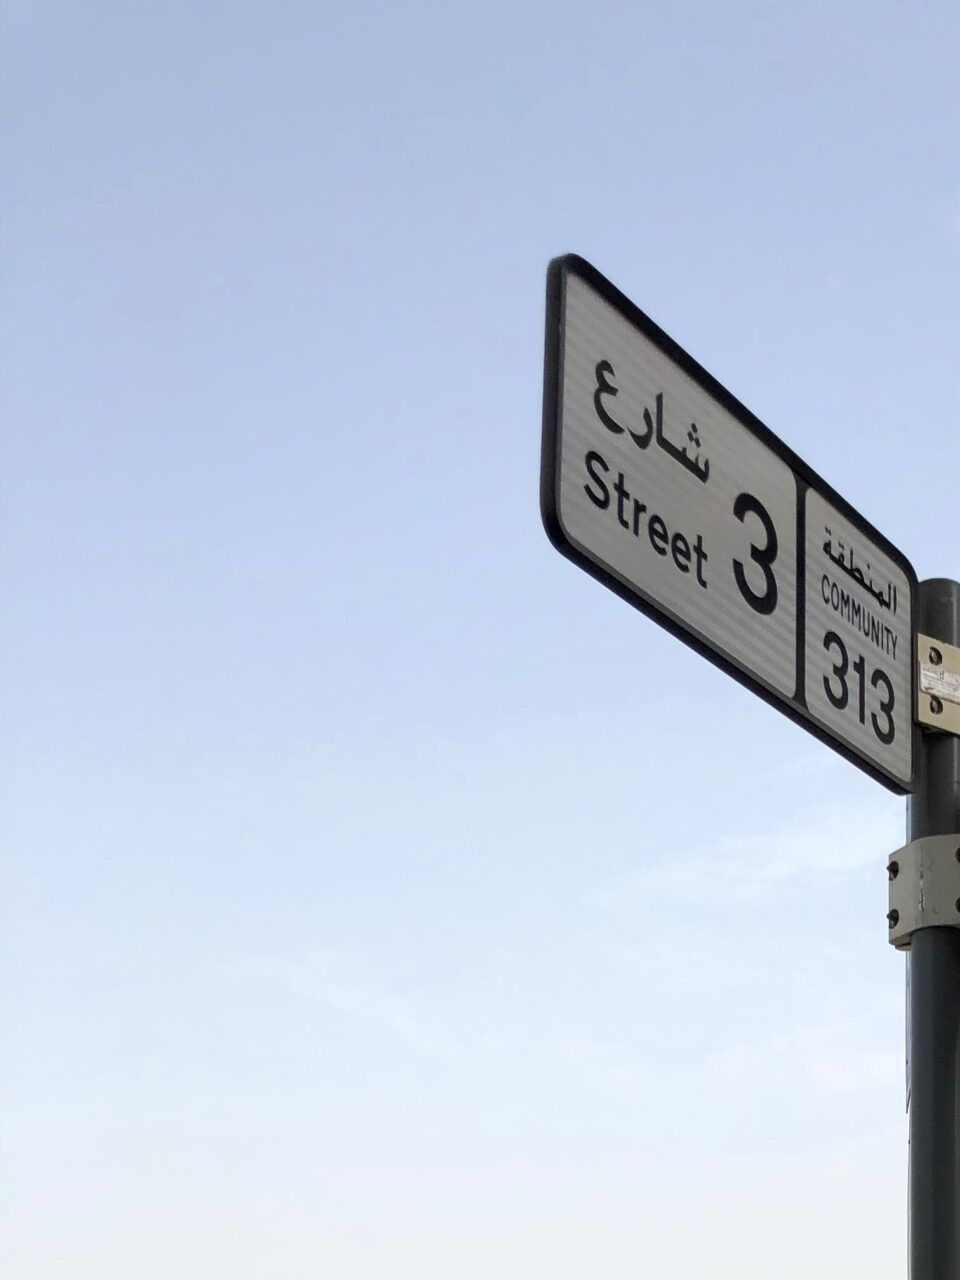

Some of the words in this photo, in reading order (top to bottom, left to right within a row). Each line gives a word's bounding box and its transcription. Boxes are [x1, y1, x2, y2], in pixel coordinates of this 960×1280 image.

[593, 359, 710, 484] شارع
[583, 450, 708, 590] Street
[732, 492, 779, 616] 3
[822, 525, 898, 615] المنطقة
[821, 573, 898, 660] COMMUNITY
[822, 630, 896, 746] 313
